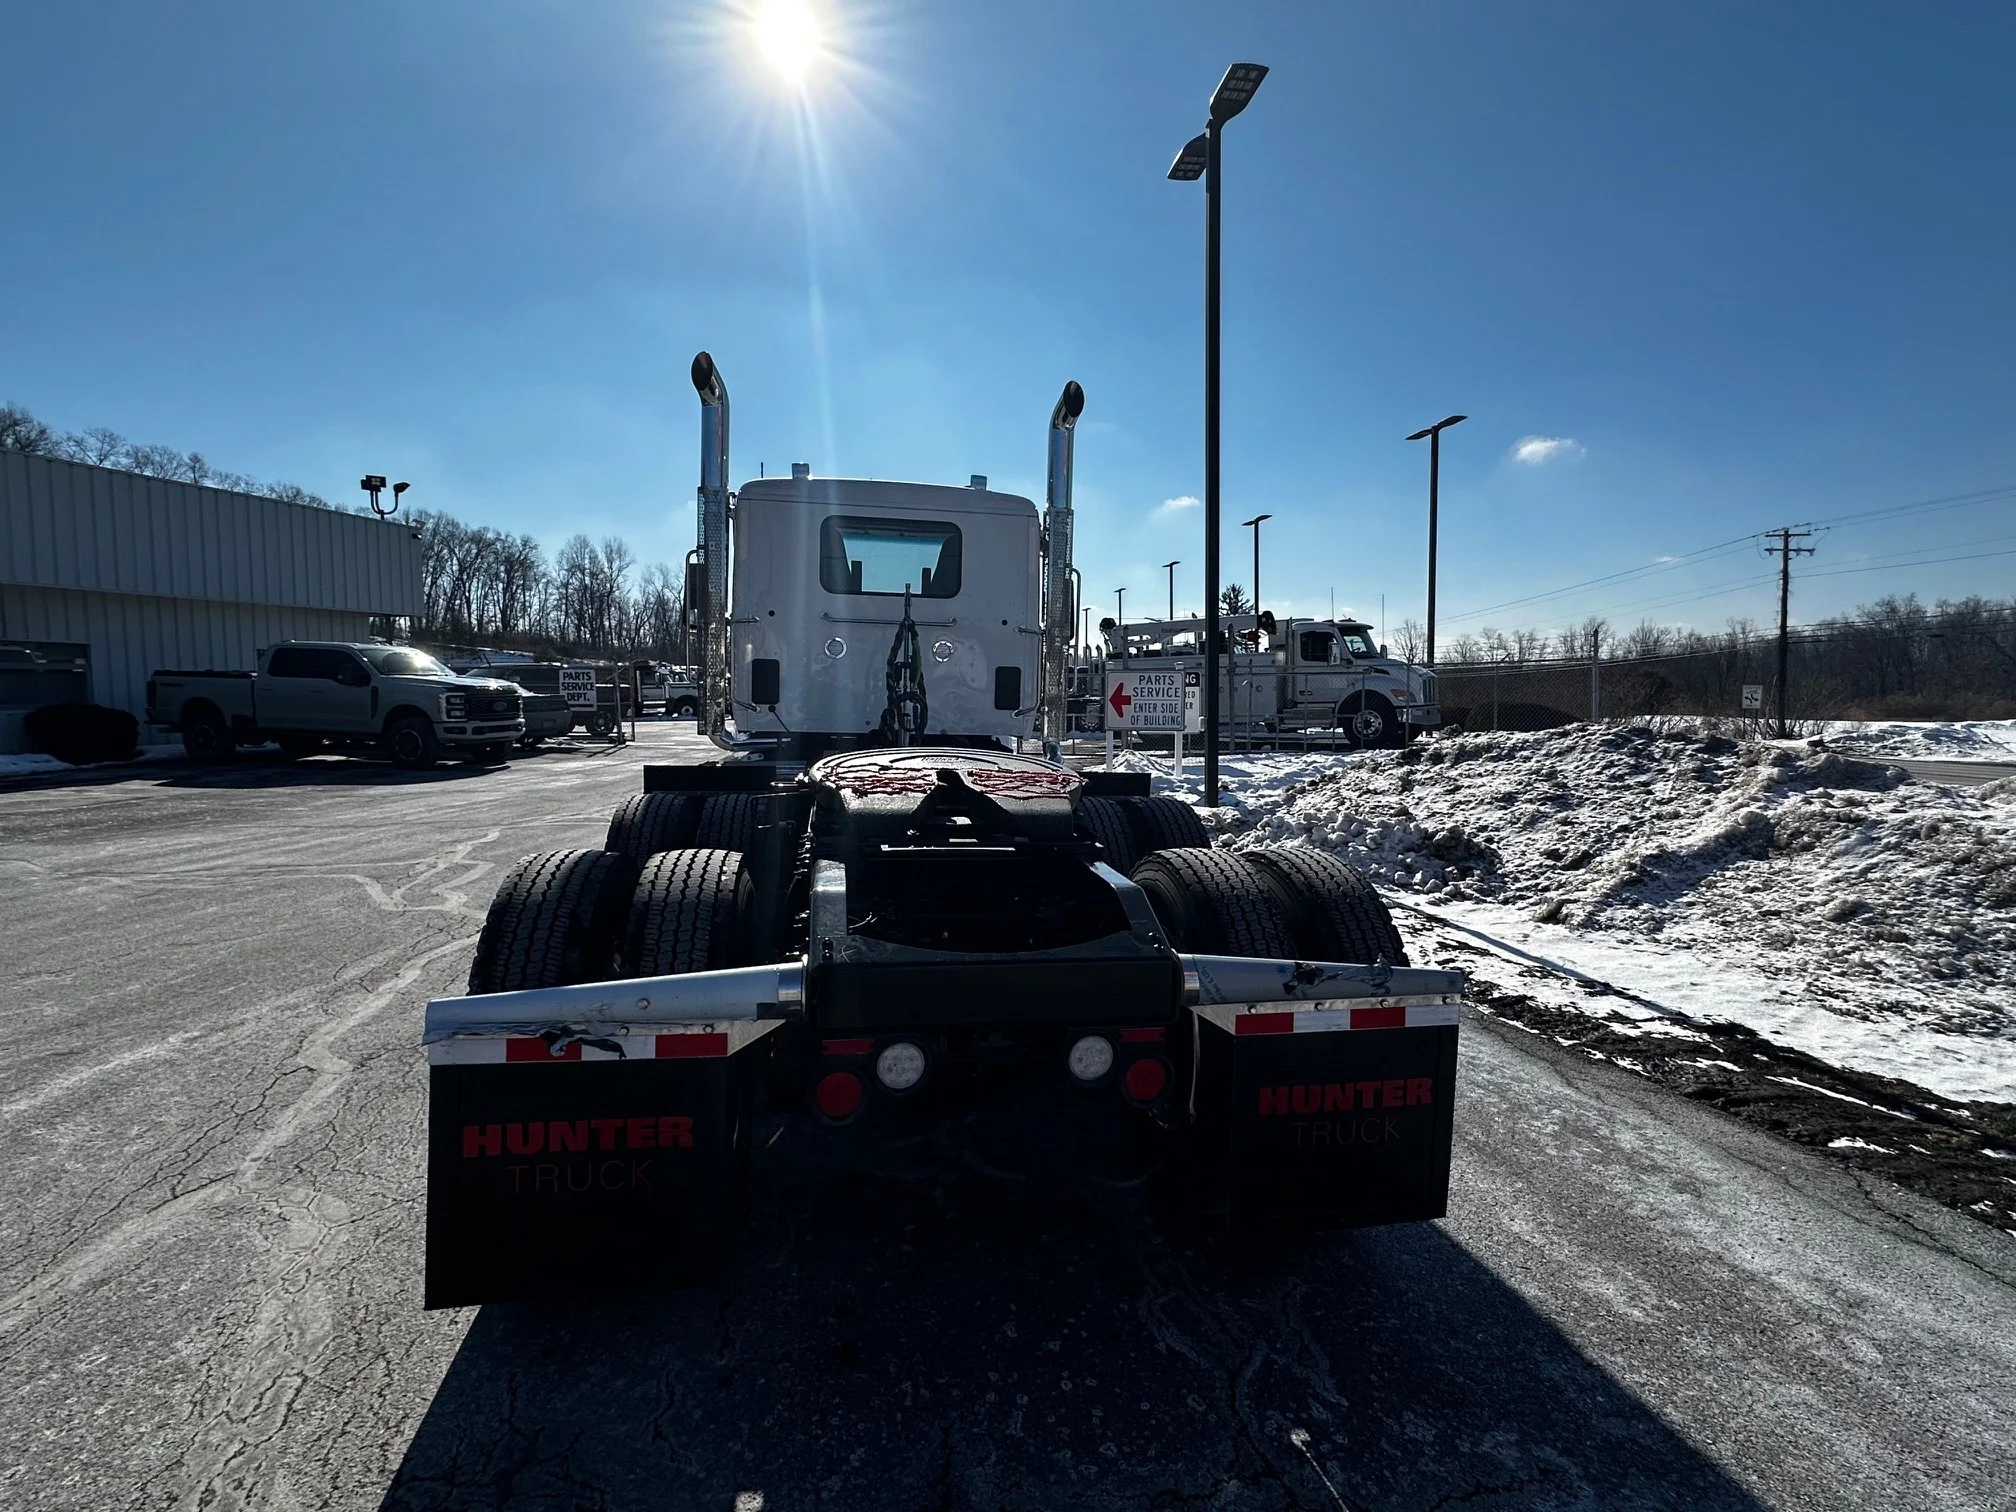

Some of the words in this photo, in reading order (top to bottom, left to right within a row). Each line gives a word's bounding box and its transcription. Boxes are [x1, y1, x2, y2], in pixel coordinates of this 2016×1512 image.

[562, 671, 592, 681] PARTS
[1138, 674, 1175, 686] PARTS
[561, 682, 594, 691] SERVICE
[566, 692, 590, 702] DEPT.
[1132, 687, 1181, 698] SERVICE
[1133, 703, 1158, 714] ENTER
[1160, 703, 1179, 714] SIDE
[1130, 715, 1142, 726] OF
[1143, 715, 1181, 726] BUILDING
[1258, 1077, 1433, 1116] HUNTER
[462, 1116, 694, 1159] HUNTER
[1289, 1115, 1401, 1149] TRUCK
[506, 1159, 652, 1195] TRUCK
